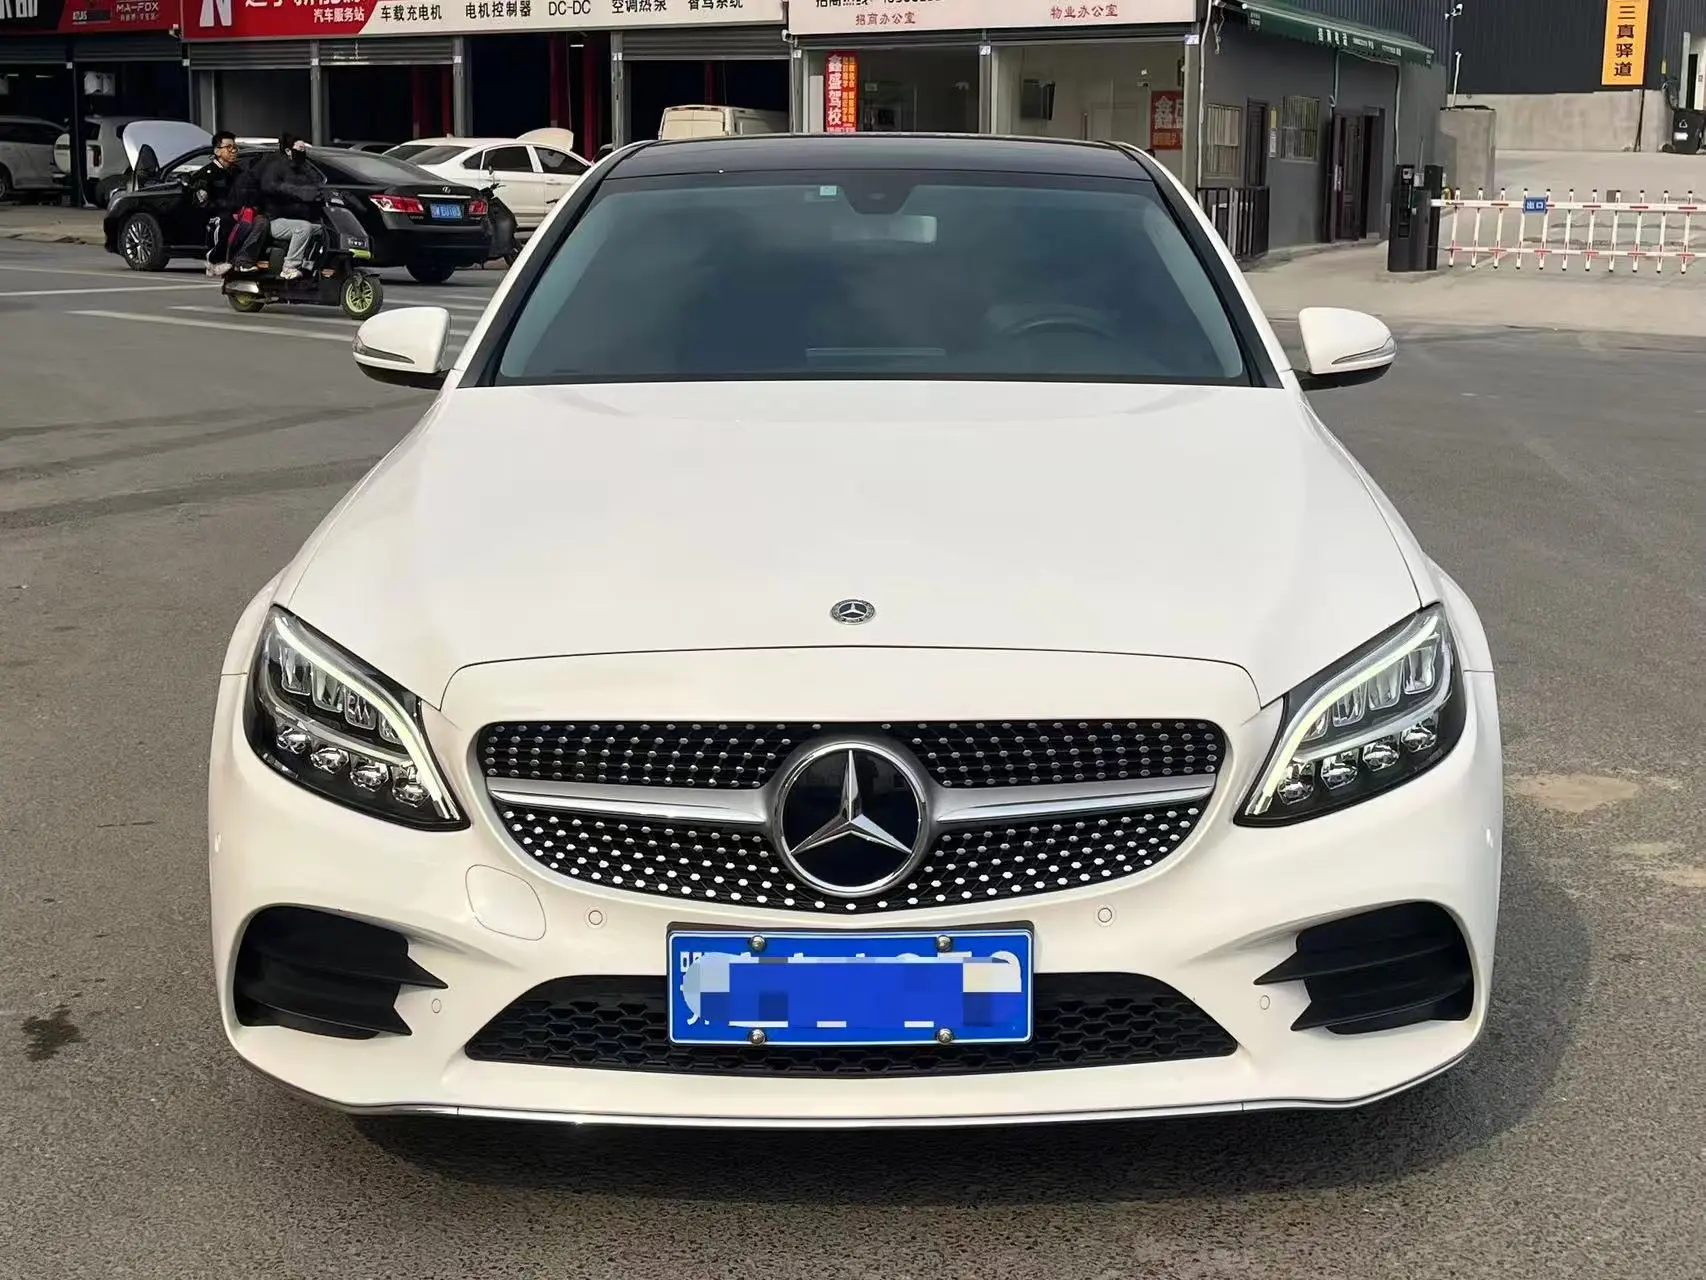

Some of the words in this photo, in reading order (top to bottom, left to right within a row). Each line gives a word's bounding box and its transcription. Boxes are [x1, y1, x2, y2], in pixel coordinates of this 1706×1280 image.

[313, 8, 365, 23] 汽车服务站
[380, 4, 442, 21] 车载充电机
[465, 1, 531, 18] 电机控制器
[548, 1, 591, 16] DC-DC
[1050, 4, 1118, 19] 物业办公室
[855, 12, 916, 26] 招商办公室
[1614, 5, 1635, 76] 三真驿道
